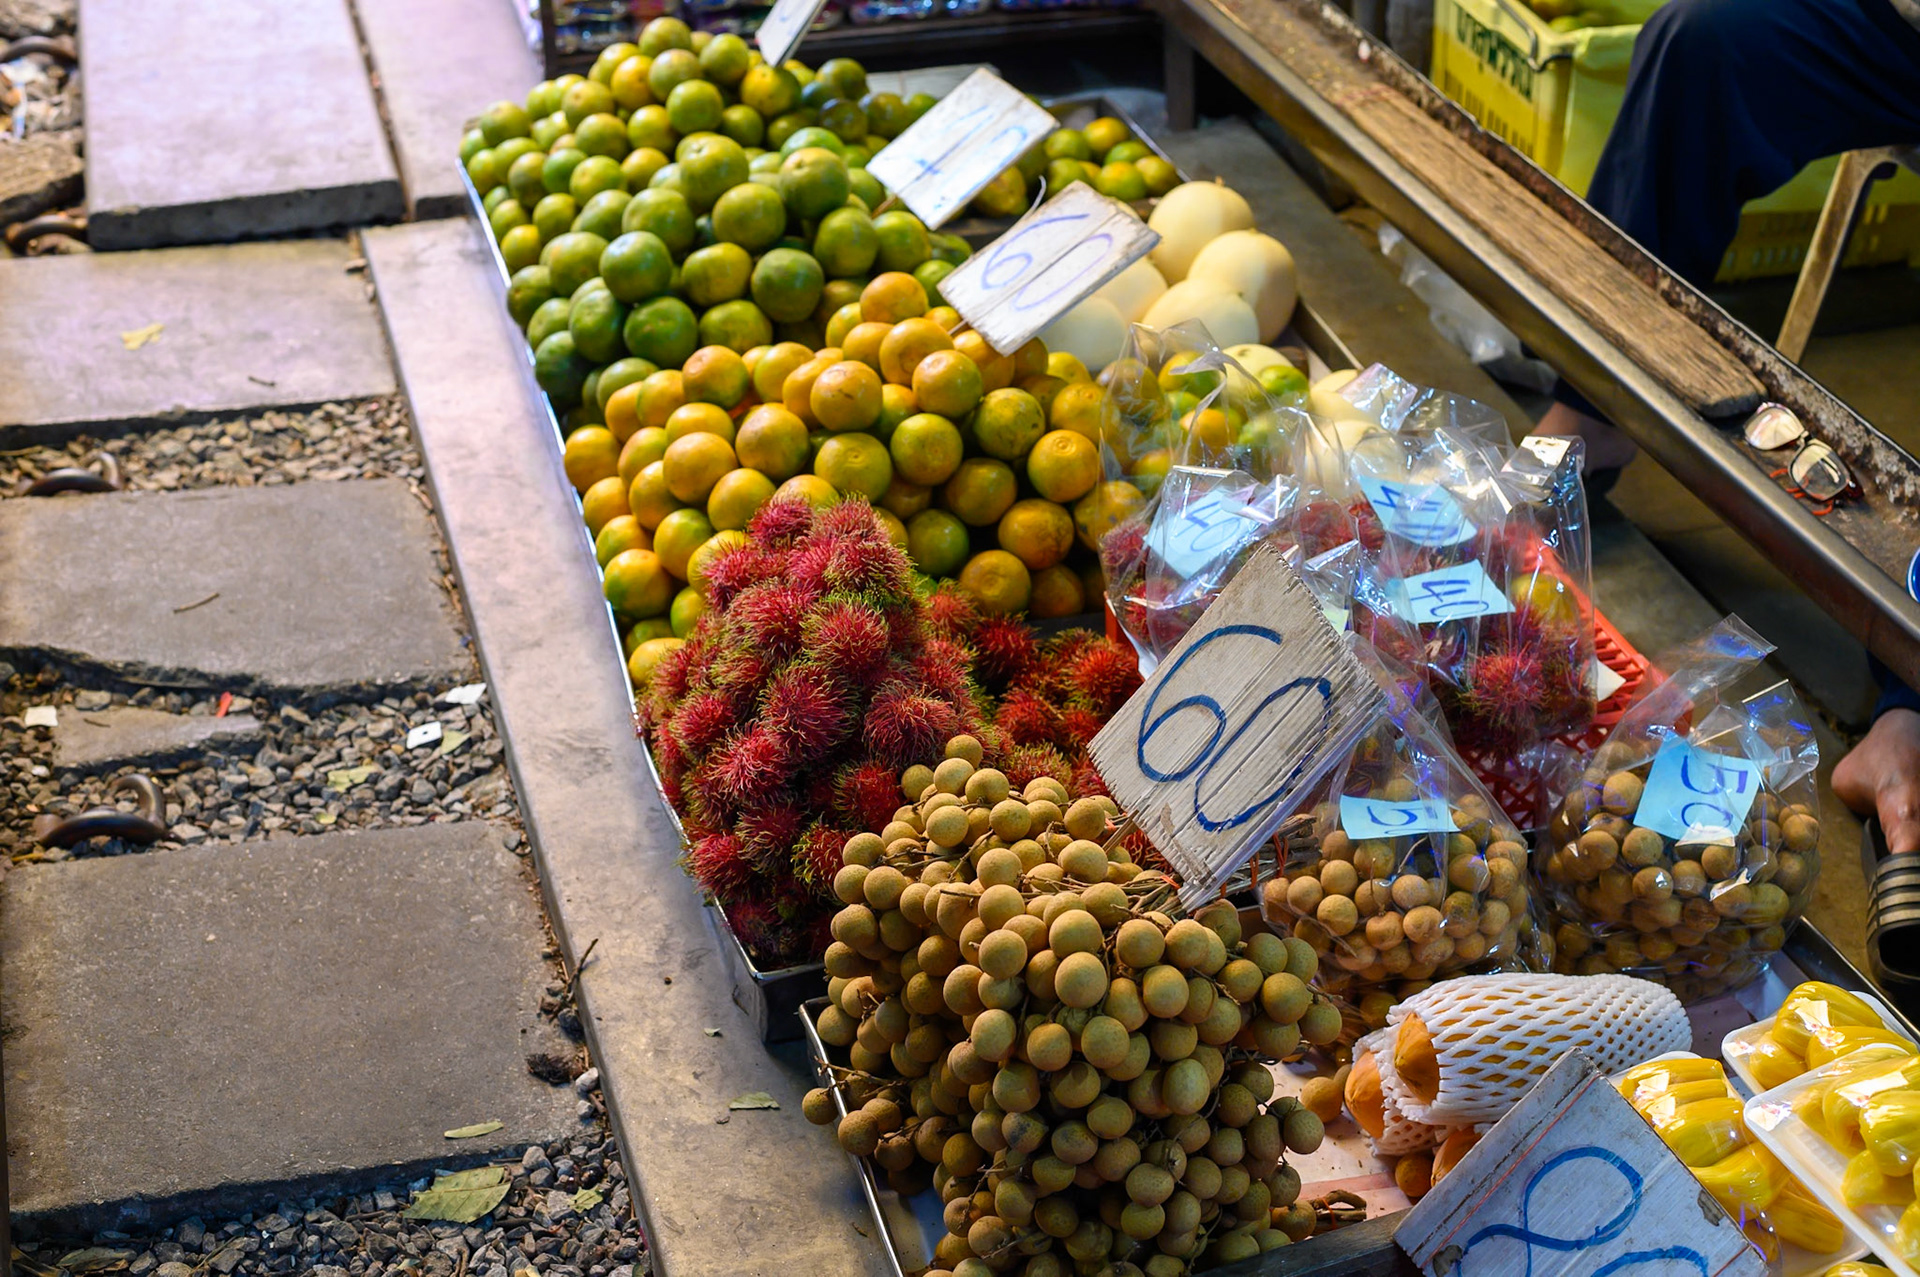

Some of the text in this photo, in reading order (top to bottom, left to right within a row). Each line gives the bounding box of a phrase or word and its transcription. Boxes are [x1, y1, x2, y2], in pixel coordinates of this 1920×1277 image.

[981, 213, 1114, 312] 60
[1410, 579, 1490, 618] 40
[1137, 623, 1333, 833] 60
[1680, 754, 1749, 834] 50
